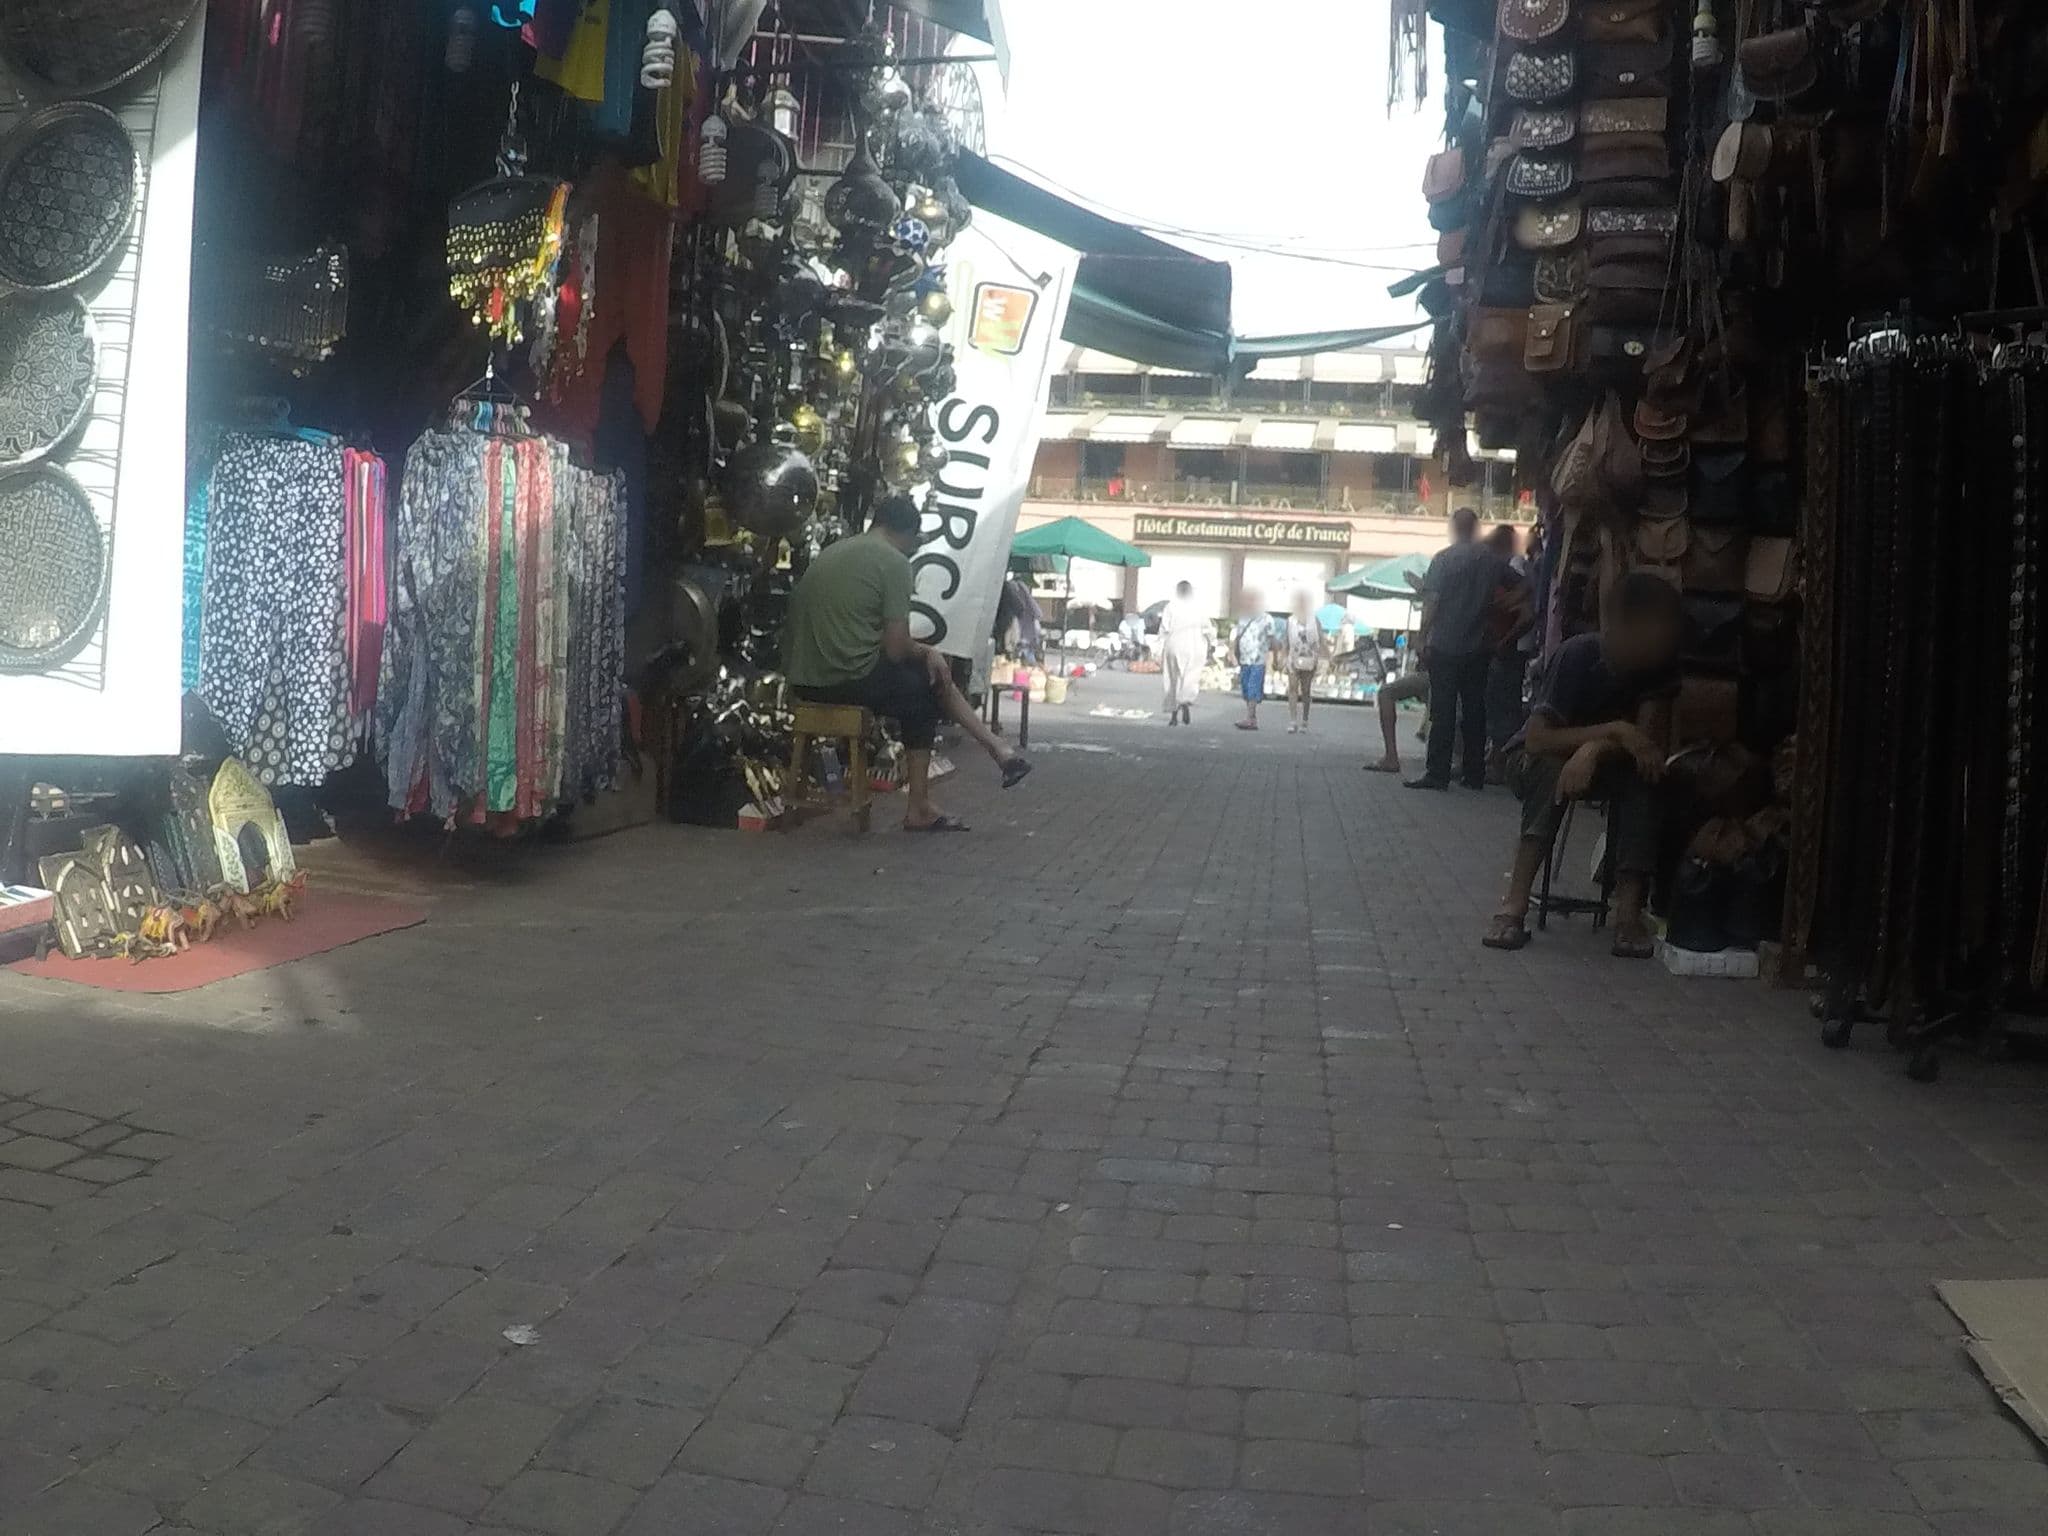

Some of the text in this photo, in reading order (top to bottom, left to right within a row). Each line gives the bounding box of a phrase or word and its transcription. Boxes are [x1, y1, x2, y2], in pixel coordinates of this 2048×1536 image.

[1135, 517, 1350, 544] Hôtel Restaurant Café de France
